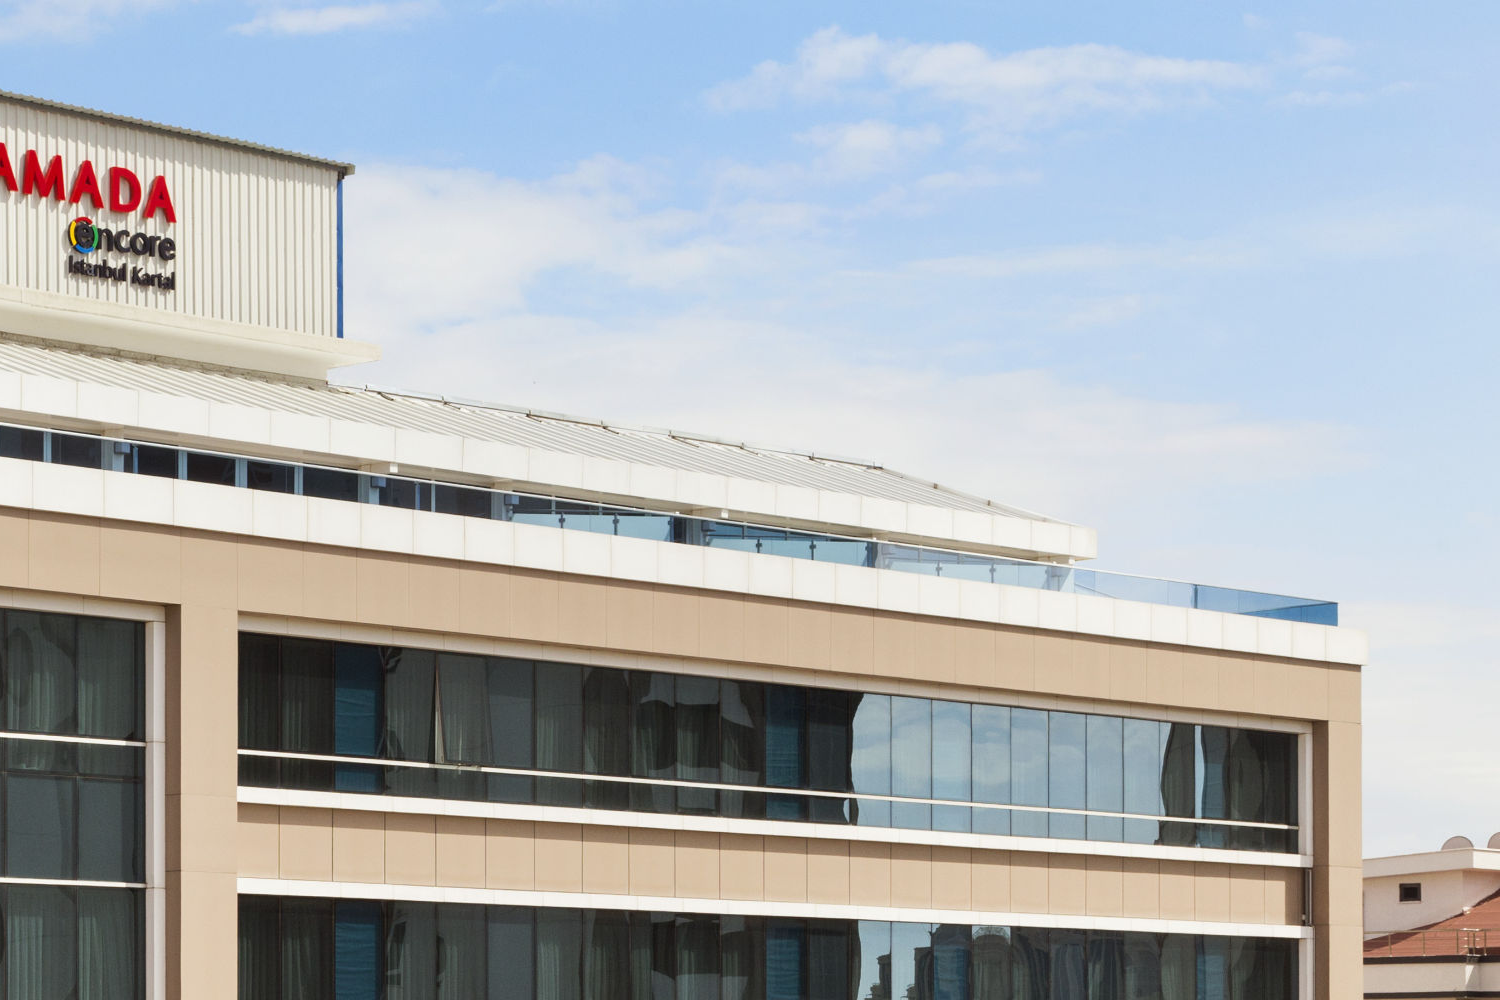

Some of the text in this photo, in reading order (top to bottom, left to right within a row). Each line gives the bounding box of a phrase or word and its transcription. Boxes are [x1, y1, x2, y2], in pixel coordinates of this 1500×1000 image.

[68, 217, 176, 261] encore
[68, 255, 176, 291] Istanbul Kartal
